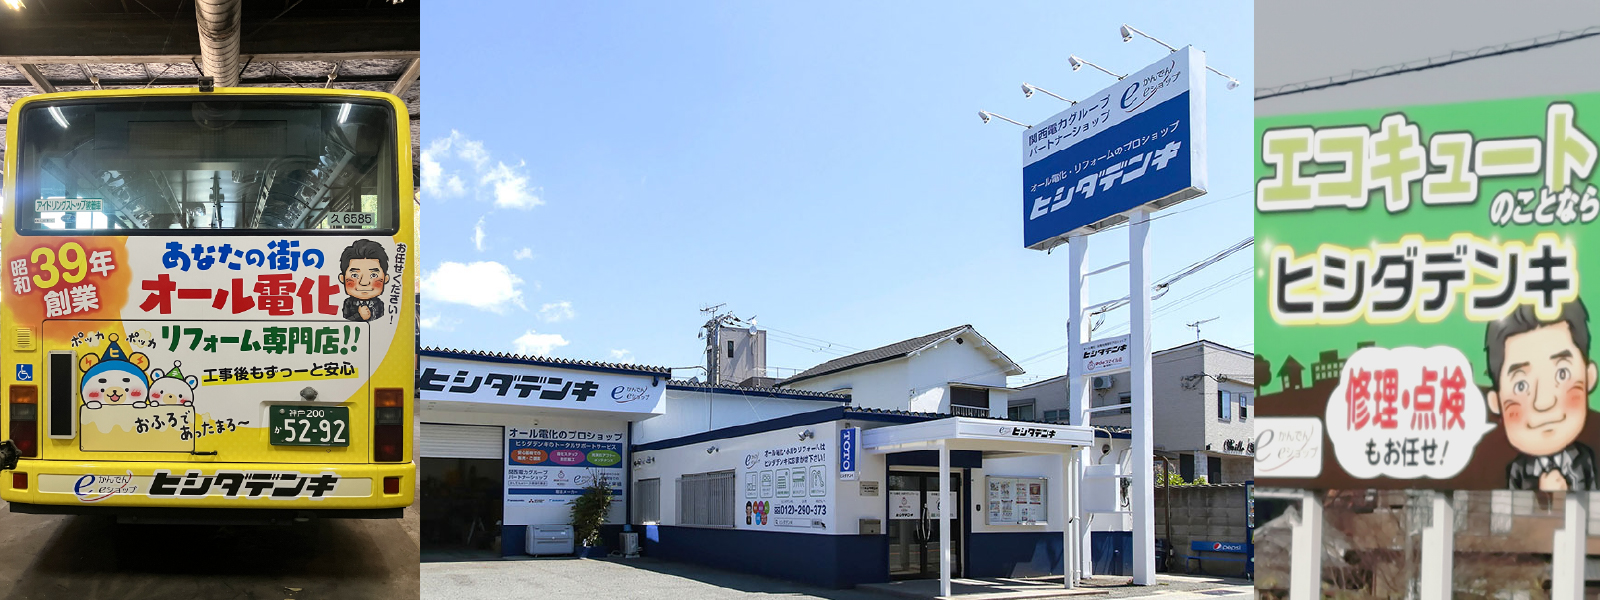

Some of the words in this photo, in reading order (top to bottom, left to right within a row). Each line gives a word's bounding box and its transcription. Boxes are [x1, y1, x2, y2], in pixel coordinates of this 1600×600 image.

[1143, 67, 1171, 87] かんでん
[1028, 94, 1110, 146] 関西電力グループ
[1029, 109, 1110, 157] パートナーショップ
[1031, 120, 1180, 192] オール電化・リフォームのプロショップ
[1257, 105, 1597, 210] エコキュート
[1030, 140, 1182, 220] ヒシダデンキ
[331, 213, 340, 224] 久
[343, 213, 372, 224] 6585
[1491, 186, 1600, 225] のことなら
[162, 239, 325, 272] あなたの街の
[381, 243, 406, 325] お任せください!
[1276, 244, 1571, 313] ヒシダデンキ
[44, 284, 99, 318] 創業
[139, 273, 341, 316] オール電化
[71, 331, 105, 347] ポッカ
[126, 331, 157, 349] ポッカ
[109, 347, 119, 358] ヒ
[161, 325, 361, 355] リフォーム専門店!!
[203, 361, 356, 383] 工事後もずっーと安心
[420, 368, 599, 402] ヒシダデンキ
[1345, 366, 1467, 430] 修理・点検
[135, 410, 191, 434] おふろで
[284, 418, 346, 443] 52-92
[509, 428, 623, 441] オール電化のプロショップ
[1365, 437, 1450, 467] もお任せ!
[98, 475, 129, 484] かんでん
[98, 485, 138, 494] eショップ
[149, 472, 338, 497] ヒシダデンキ
